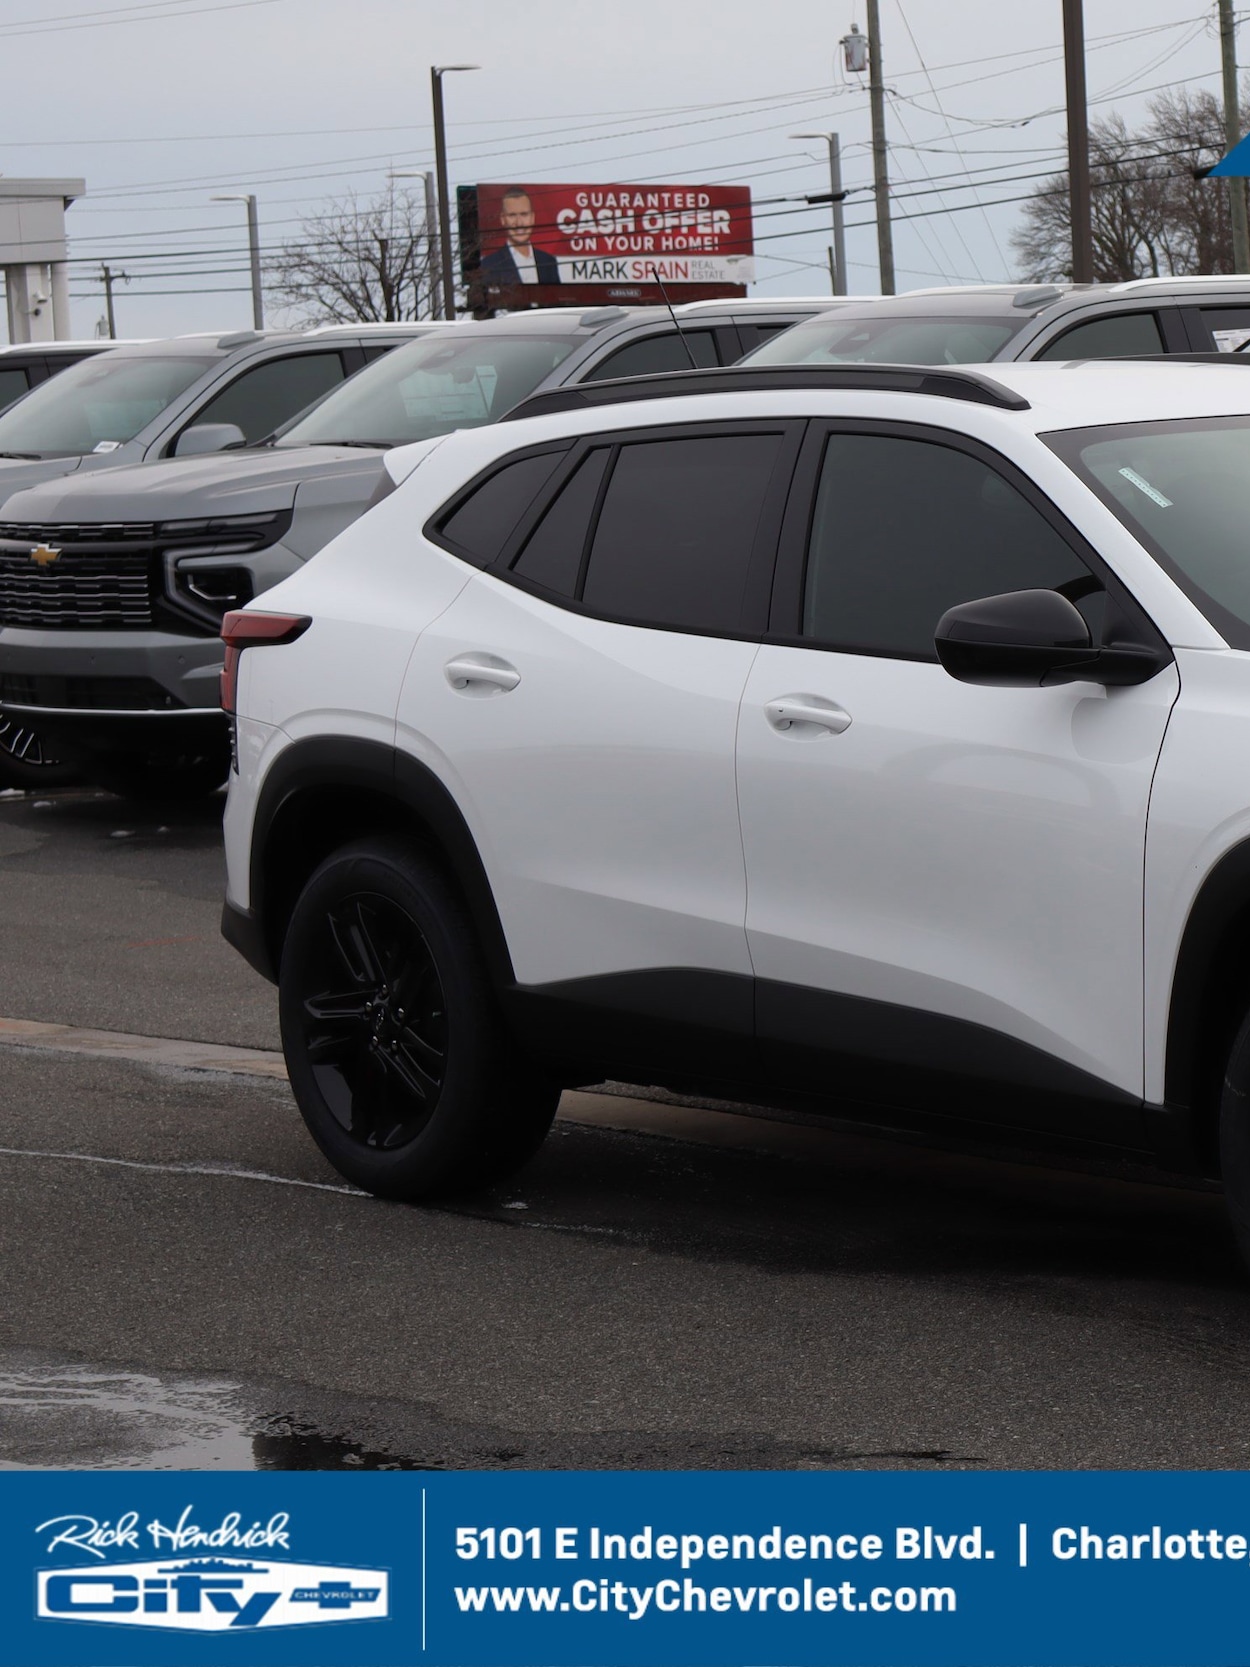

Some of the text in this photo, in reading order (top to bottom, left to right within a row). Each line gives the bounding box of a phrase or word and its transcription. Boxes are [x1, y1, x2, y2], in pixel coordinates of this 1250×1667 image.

[576, 192, 710, 208] GUARANTEED
[556, 208, 731, 235] CASH OFFER
[570, 236, 719, 251] ON YOUR HOME!
[572, 260, 689, 280] MARK SPAIN
[691, 260, 715, 270] REAL
[691, 270, 726, 280] ESTATE
